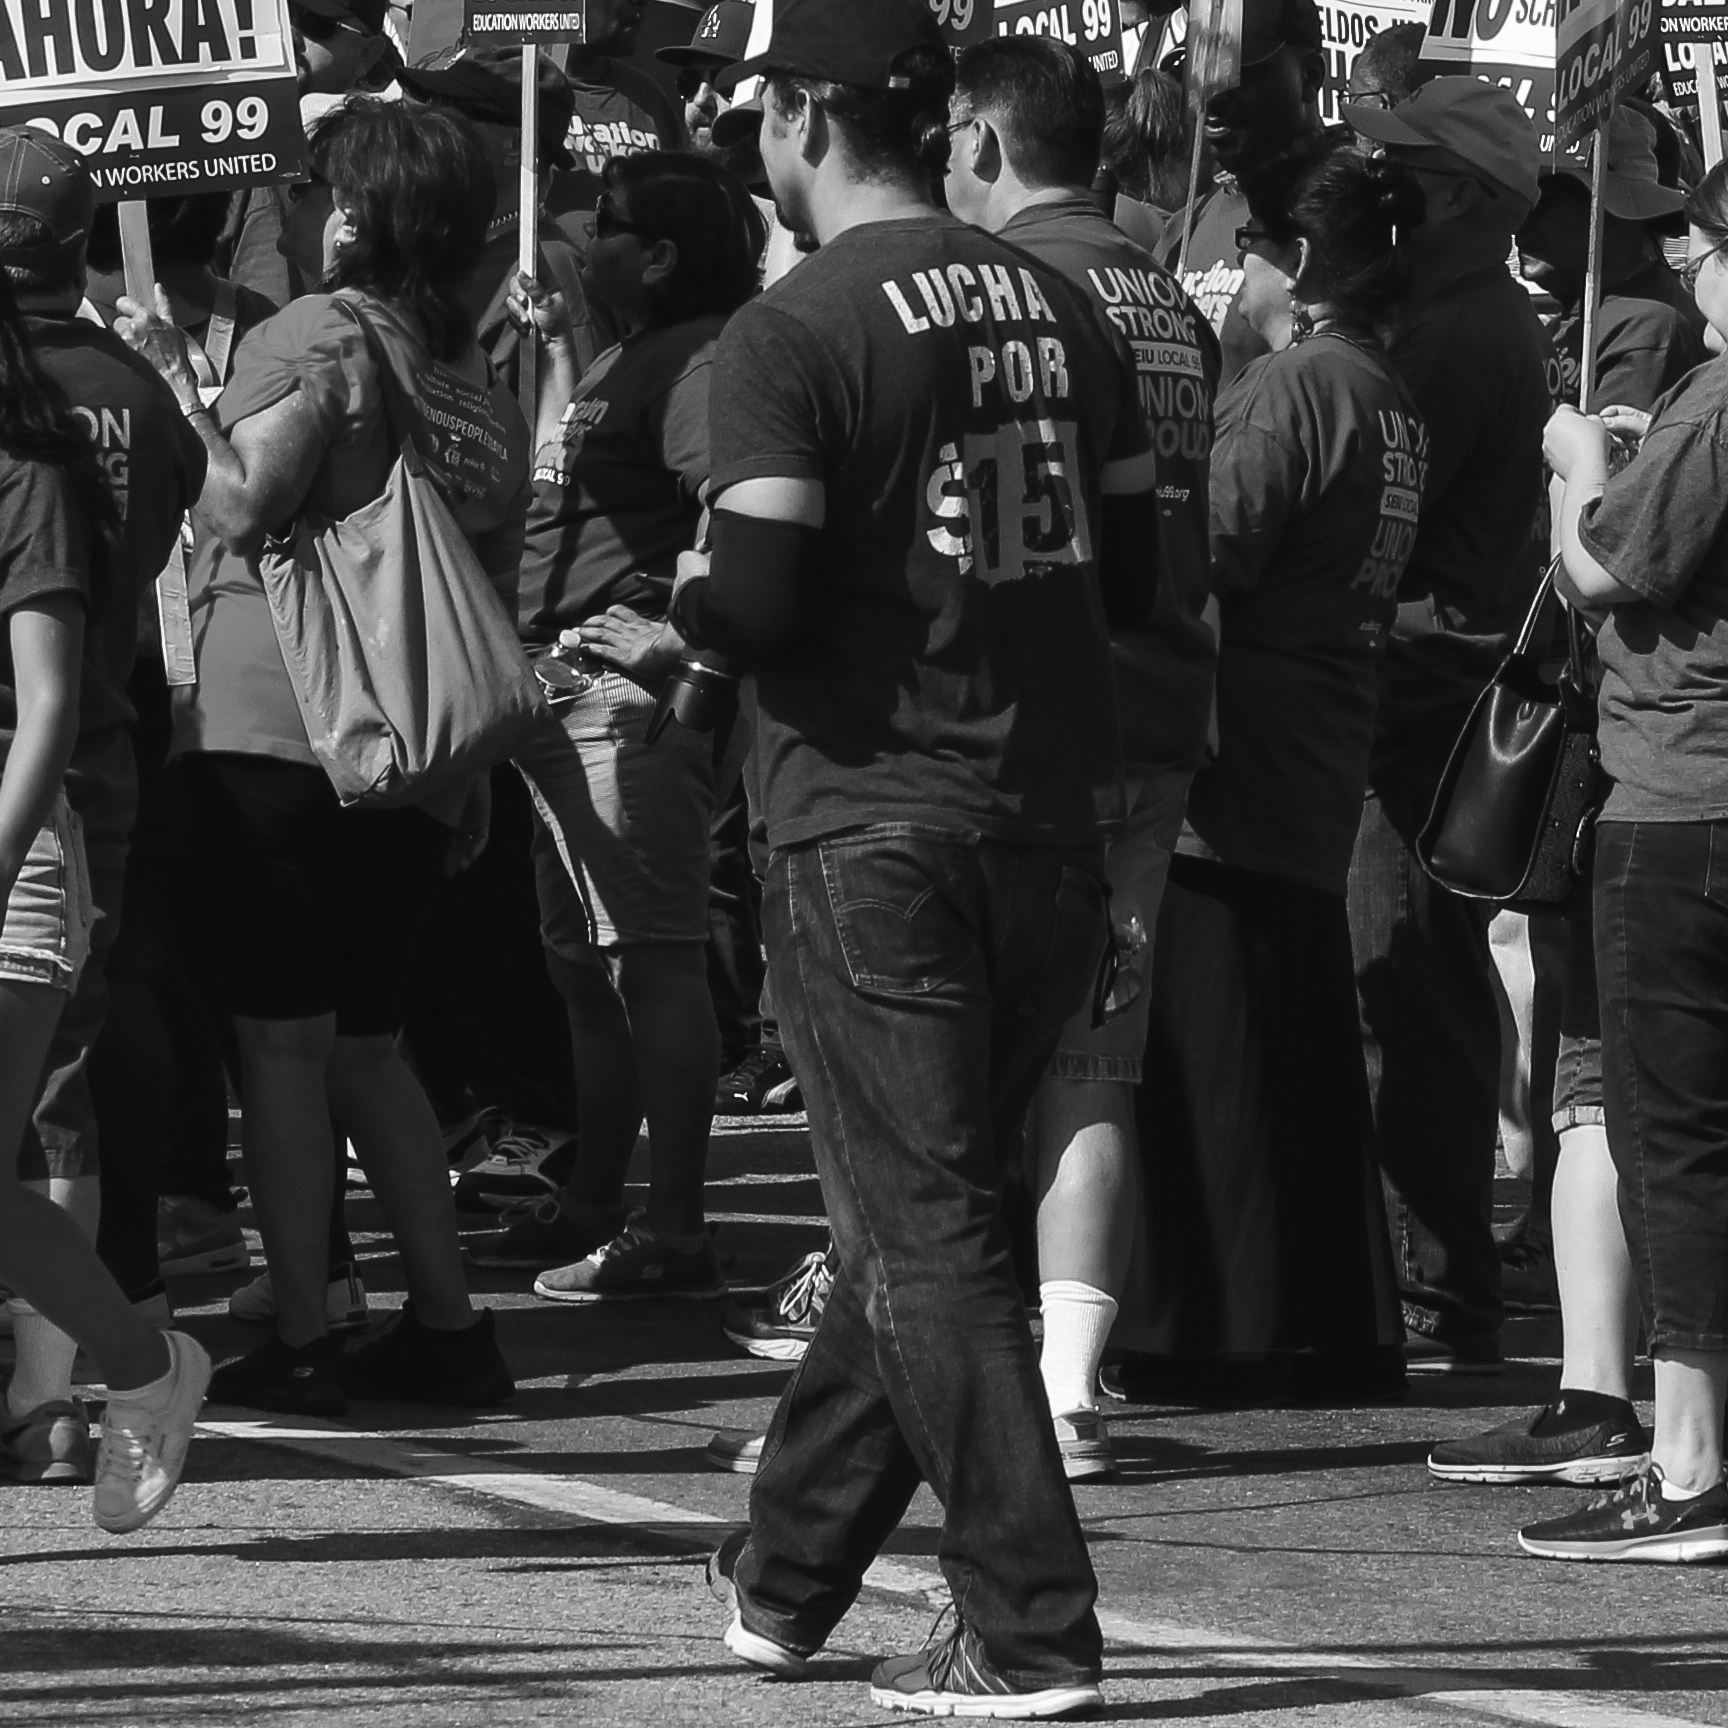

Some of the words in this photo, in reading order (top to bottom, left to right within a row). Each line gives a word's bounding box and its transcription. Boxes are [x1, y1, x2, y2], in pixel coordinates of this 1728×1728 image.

[105, 159, 201, 186] WORKERS
[205, 153, 277, 177] UNITED
[881, 263, 1057, 334] LUCHA
[1105, 305, 1197, 345] STRONG
[969, 337, 1069, 408] POR
